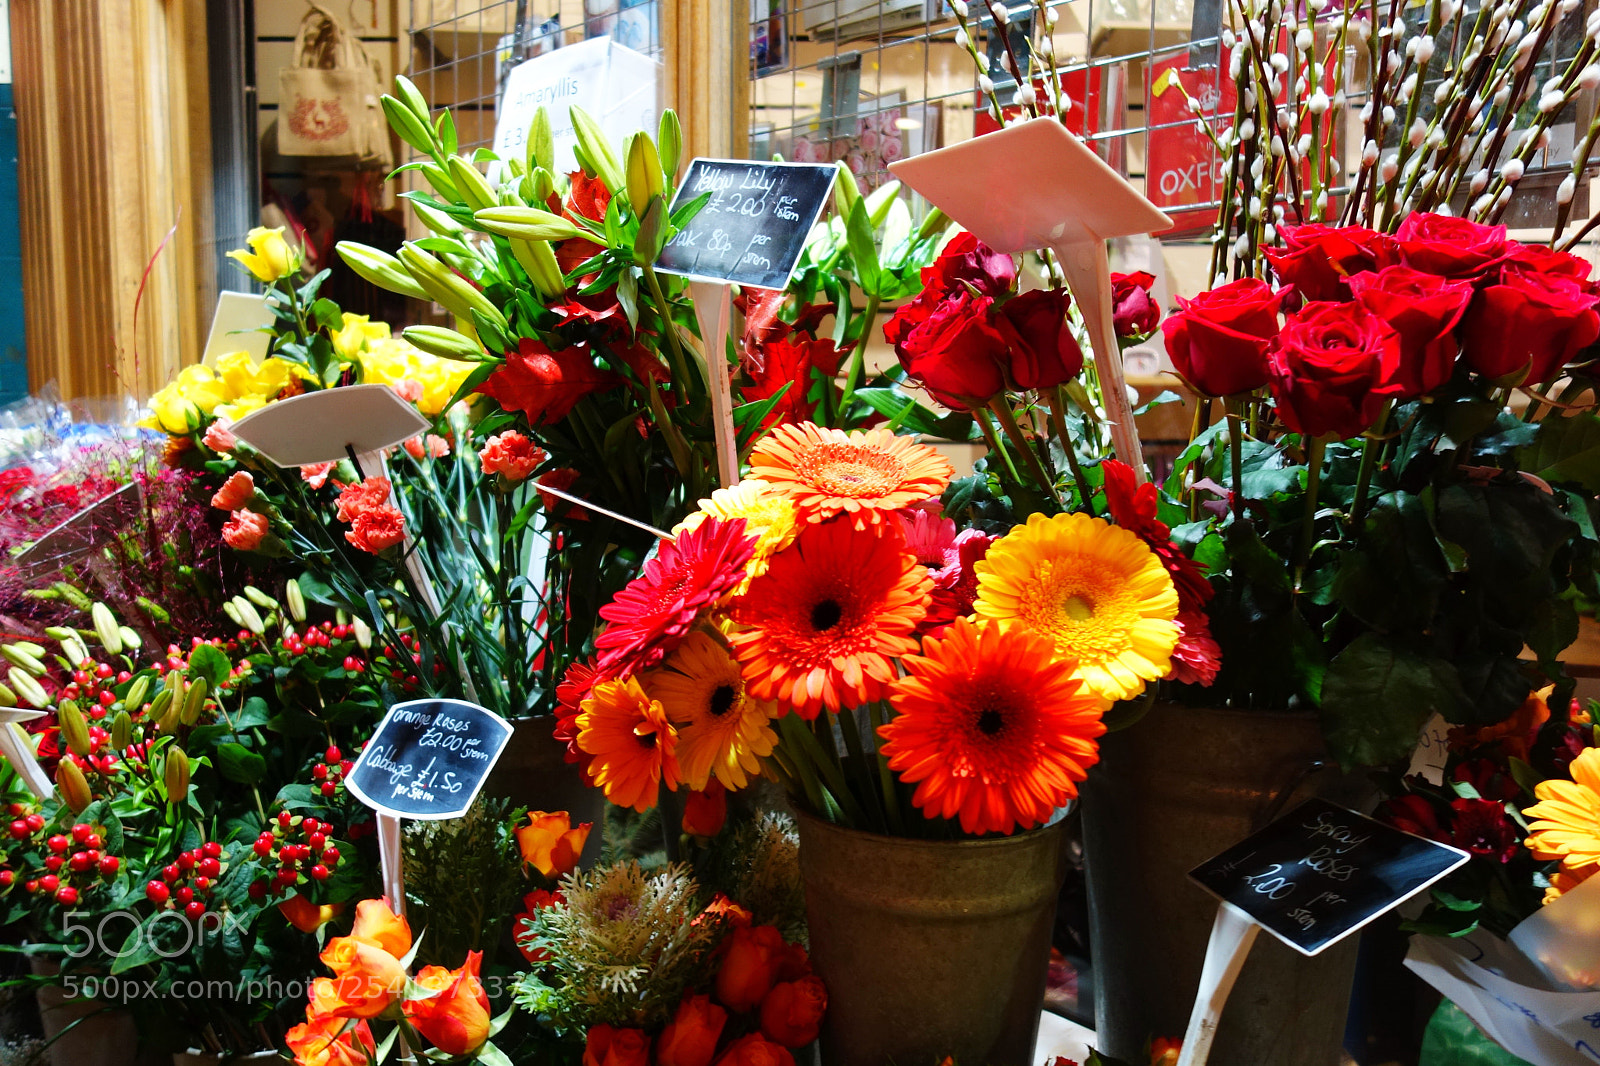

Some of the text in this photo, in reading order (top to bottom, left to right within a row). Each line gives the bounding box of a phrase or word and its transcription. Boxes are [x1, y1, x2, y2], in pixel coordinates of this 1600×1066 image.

[515, 77, 579, 108] Amaryllis
[693, 164, 735, 192] Yellow
[1160, 158, 1226, 196] OXFO
[432, 713, 471, 732] Roses
[1302, 811, 1373, 855] Spray
[1297, 844, 1360, 882] Roses
